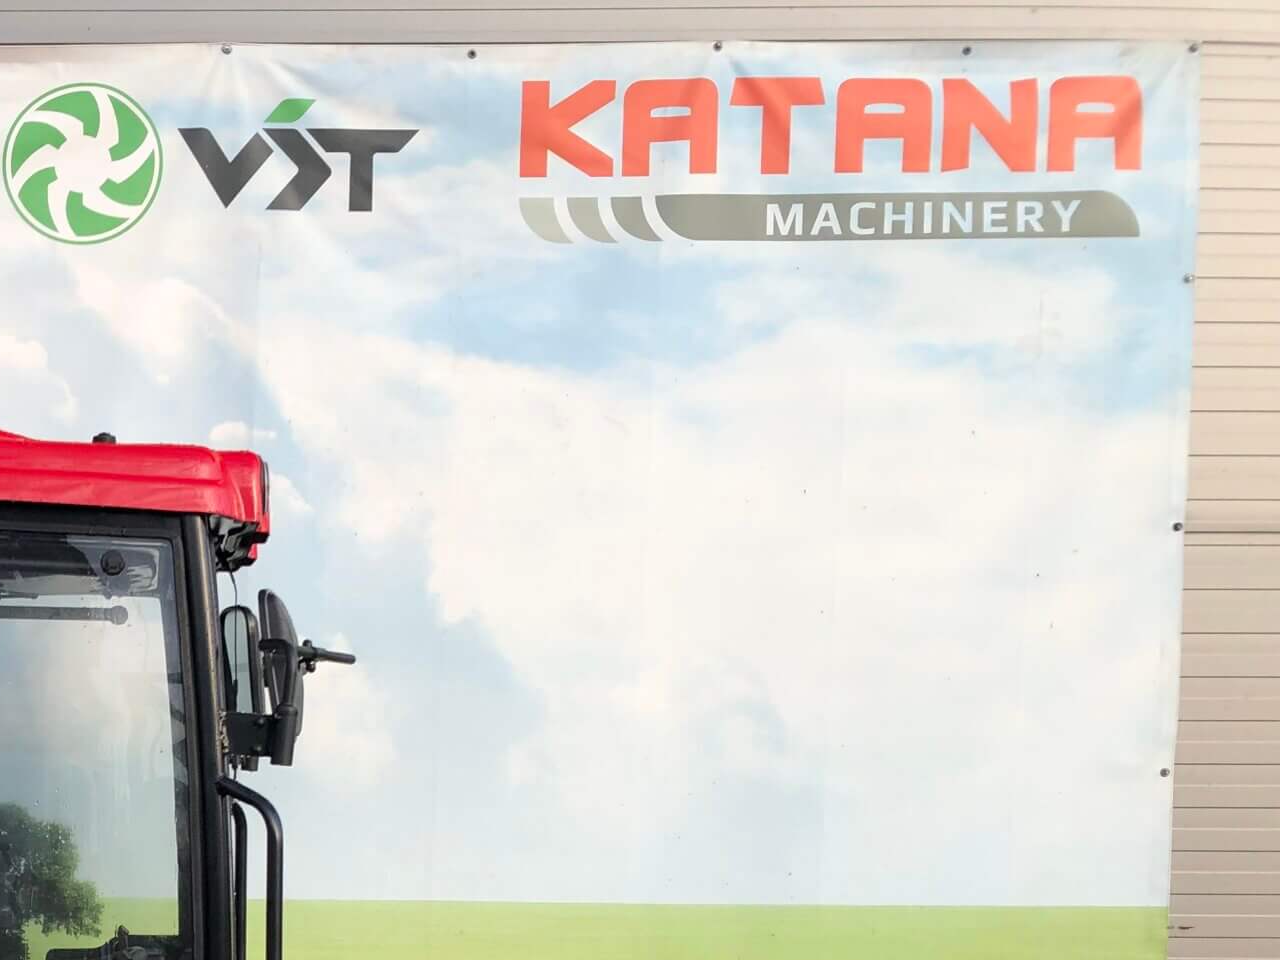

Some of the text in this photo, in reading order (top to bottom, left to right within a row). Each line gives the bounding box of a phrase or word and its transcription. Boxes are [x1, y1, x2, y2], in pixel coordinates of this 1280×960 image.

[178, 98, 420, 213] VST
[519, 75, 1143, 178] KATANA
[765, 199, 1083, 237] MACHINERY
